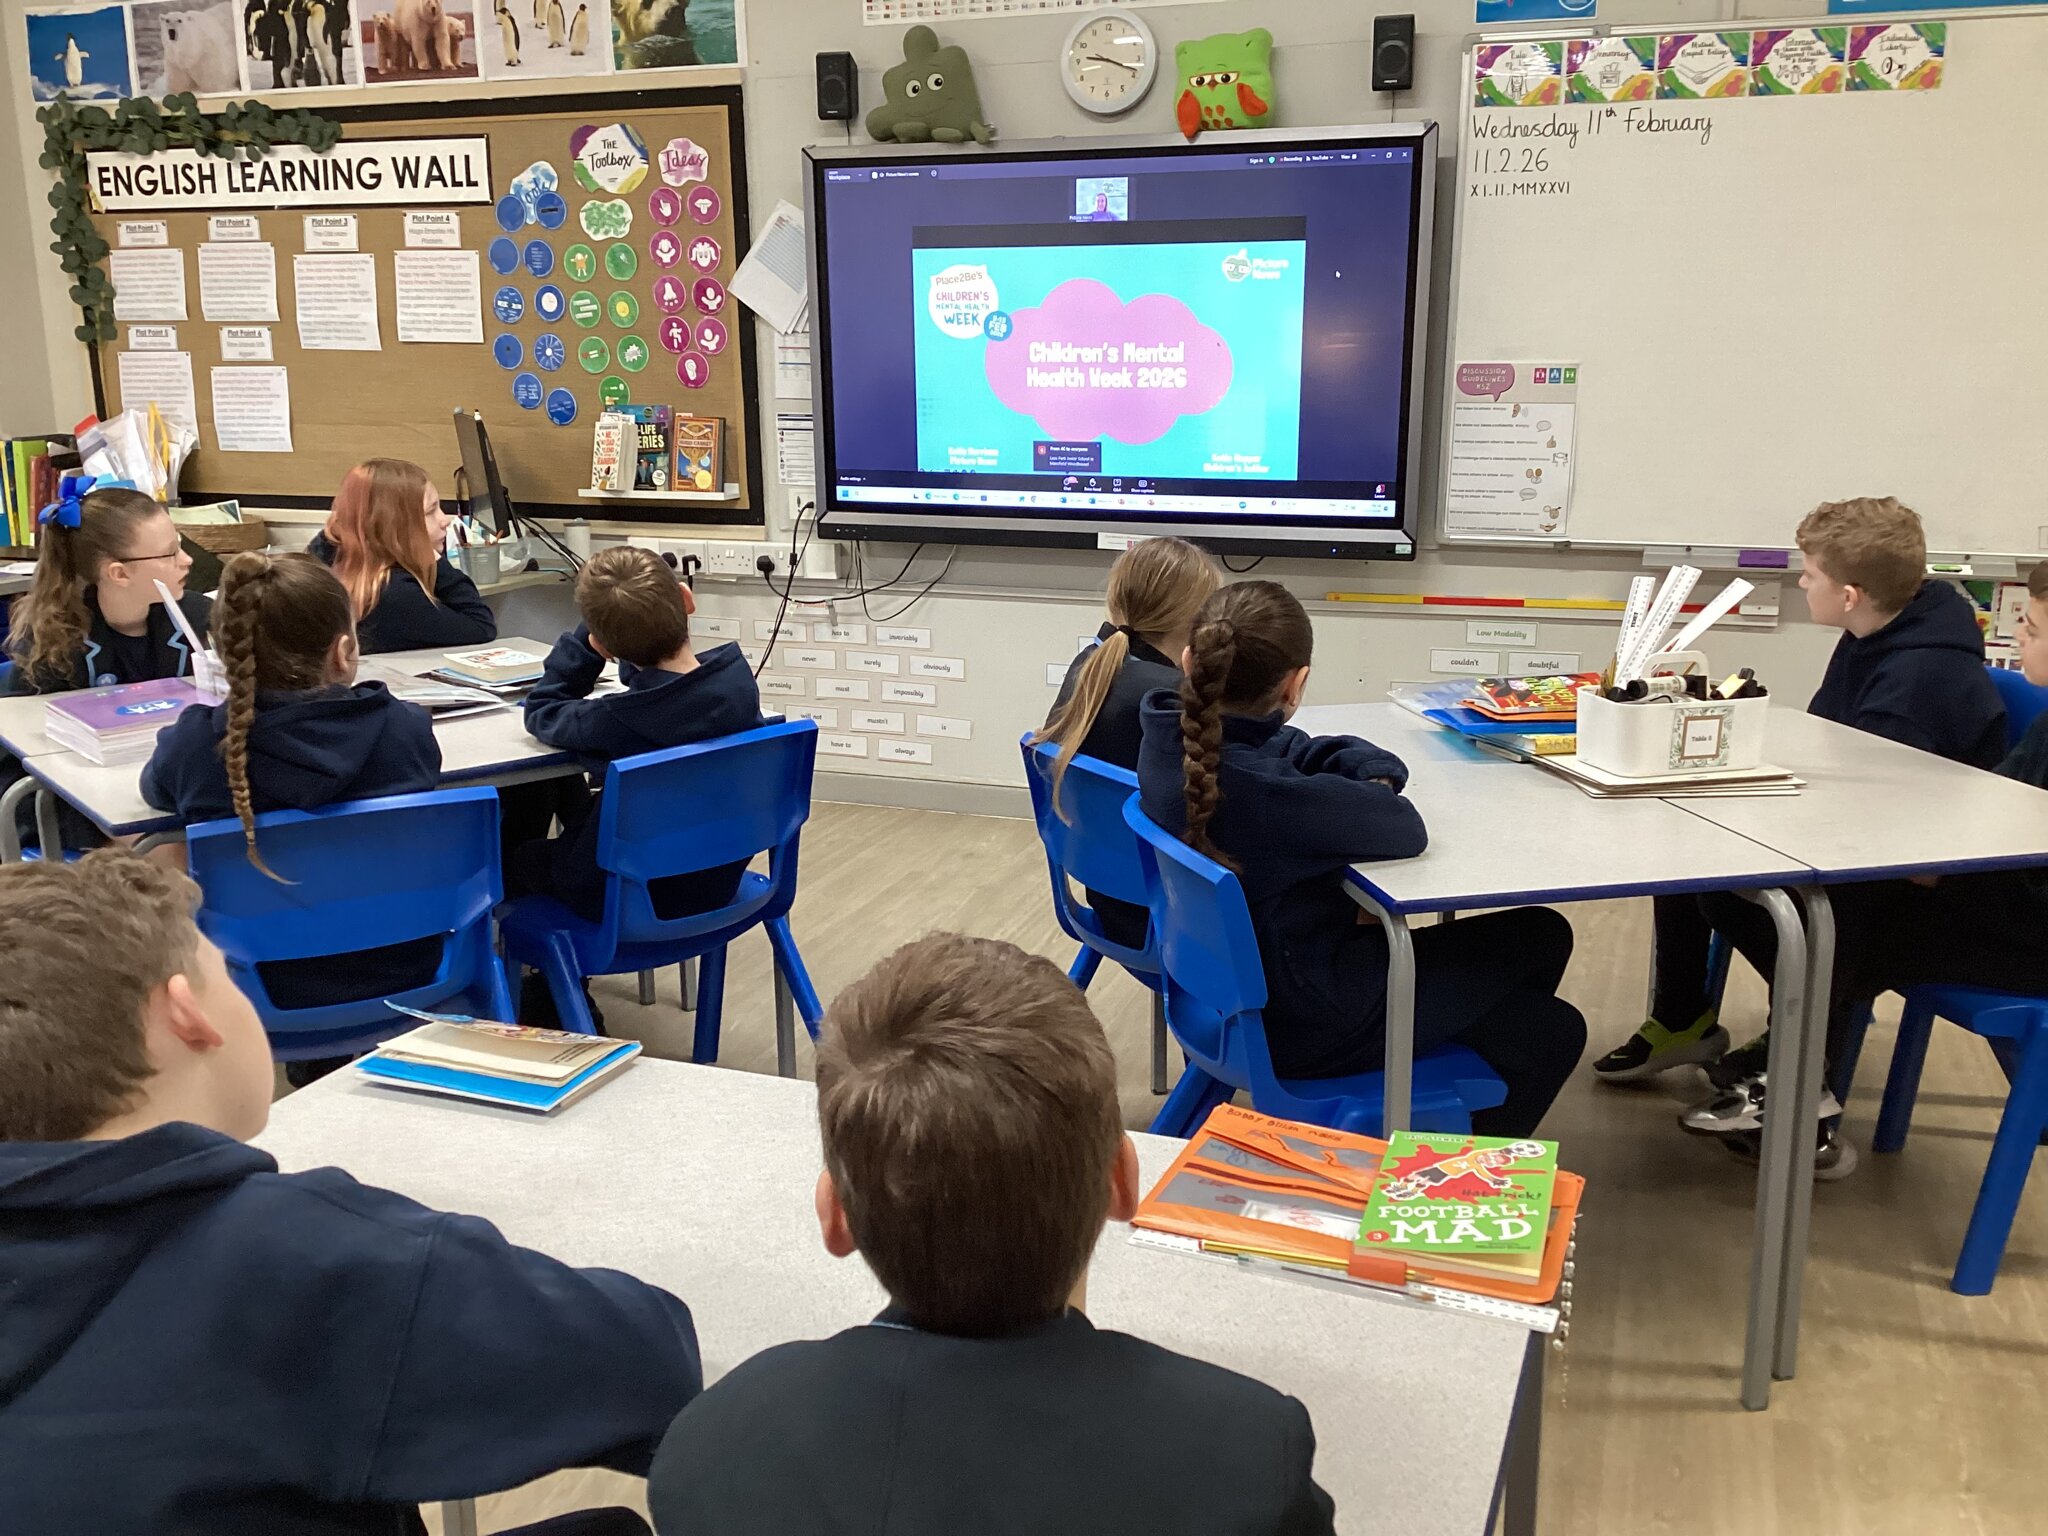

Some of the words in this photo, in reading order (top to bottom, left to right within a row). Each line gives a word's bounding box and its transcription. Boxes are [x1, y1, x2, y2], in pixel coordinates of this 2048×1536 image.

[1105, 23, 1112, 31] 12
[1120, 84, 1125, 92] 5
[1472, 112, 1580, 149] Wednesday
[1624, 107, 1713, 146] February
[601, 139, 618, 150] THE
[588, 151, 636, 172] Toolbox
[661, 149, 707, 174] Ideas
[1473, 148, 1549, 174] 11.2.26
[98, 163, 217, 198] ENGLISH
[226, 157, 383, 194] LEARNING
[391, 154, 479, 190] WALL
[936, 271, 983, 286] Place2Be's
[936, 291, 990, 302] CHILDREN'S
[944, 312, 980, 326] WEEK
[1028, 340, 1119, 363] Children's
[1123, 340, 1185, 363] Mental
[1026, 366, 1085, 388] Health
[1088, 366, 1134, 388] Week
[1136, 366, 1188, 388] 2026
[1462, 375, 1506, 383] GUIDELINES
[637, 435, 665, 449] ERIES
[889, 634, 918, 643] invariably
[1476, 629, 1491, 637] Low
[1493, 630, 1527, 640] Modality
[864, 659, 881, 668] surely
[923, 663, 951, 672] obviously
[1450, 658, 1479, 666] couldn't
[1527, 661, 1560, 670] doubtful
[767, 682, 792, 690] certainly
[893, 689, 924, 698] impossibly
[895, 748, 915, 756] always
[1226, 1108, 1264, 1123] BOBBY
[1378, 1203, 1539, 1219] FOOTBALL
[1372, 1231, 1382, 1240] 3
[1389, 1218, 1533, 1244] MAD
